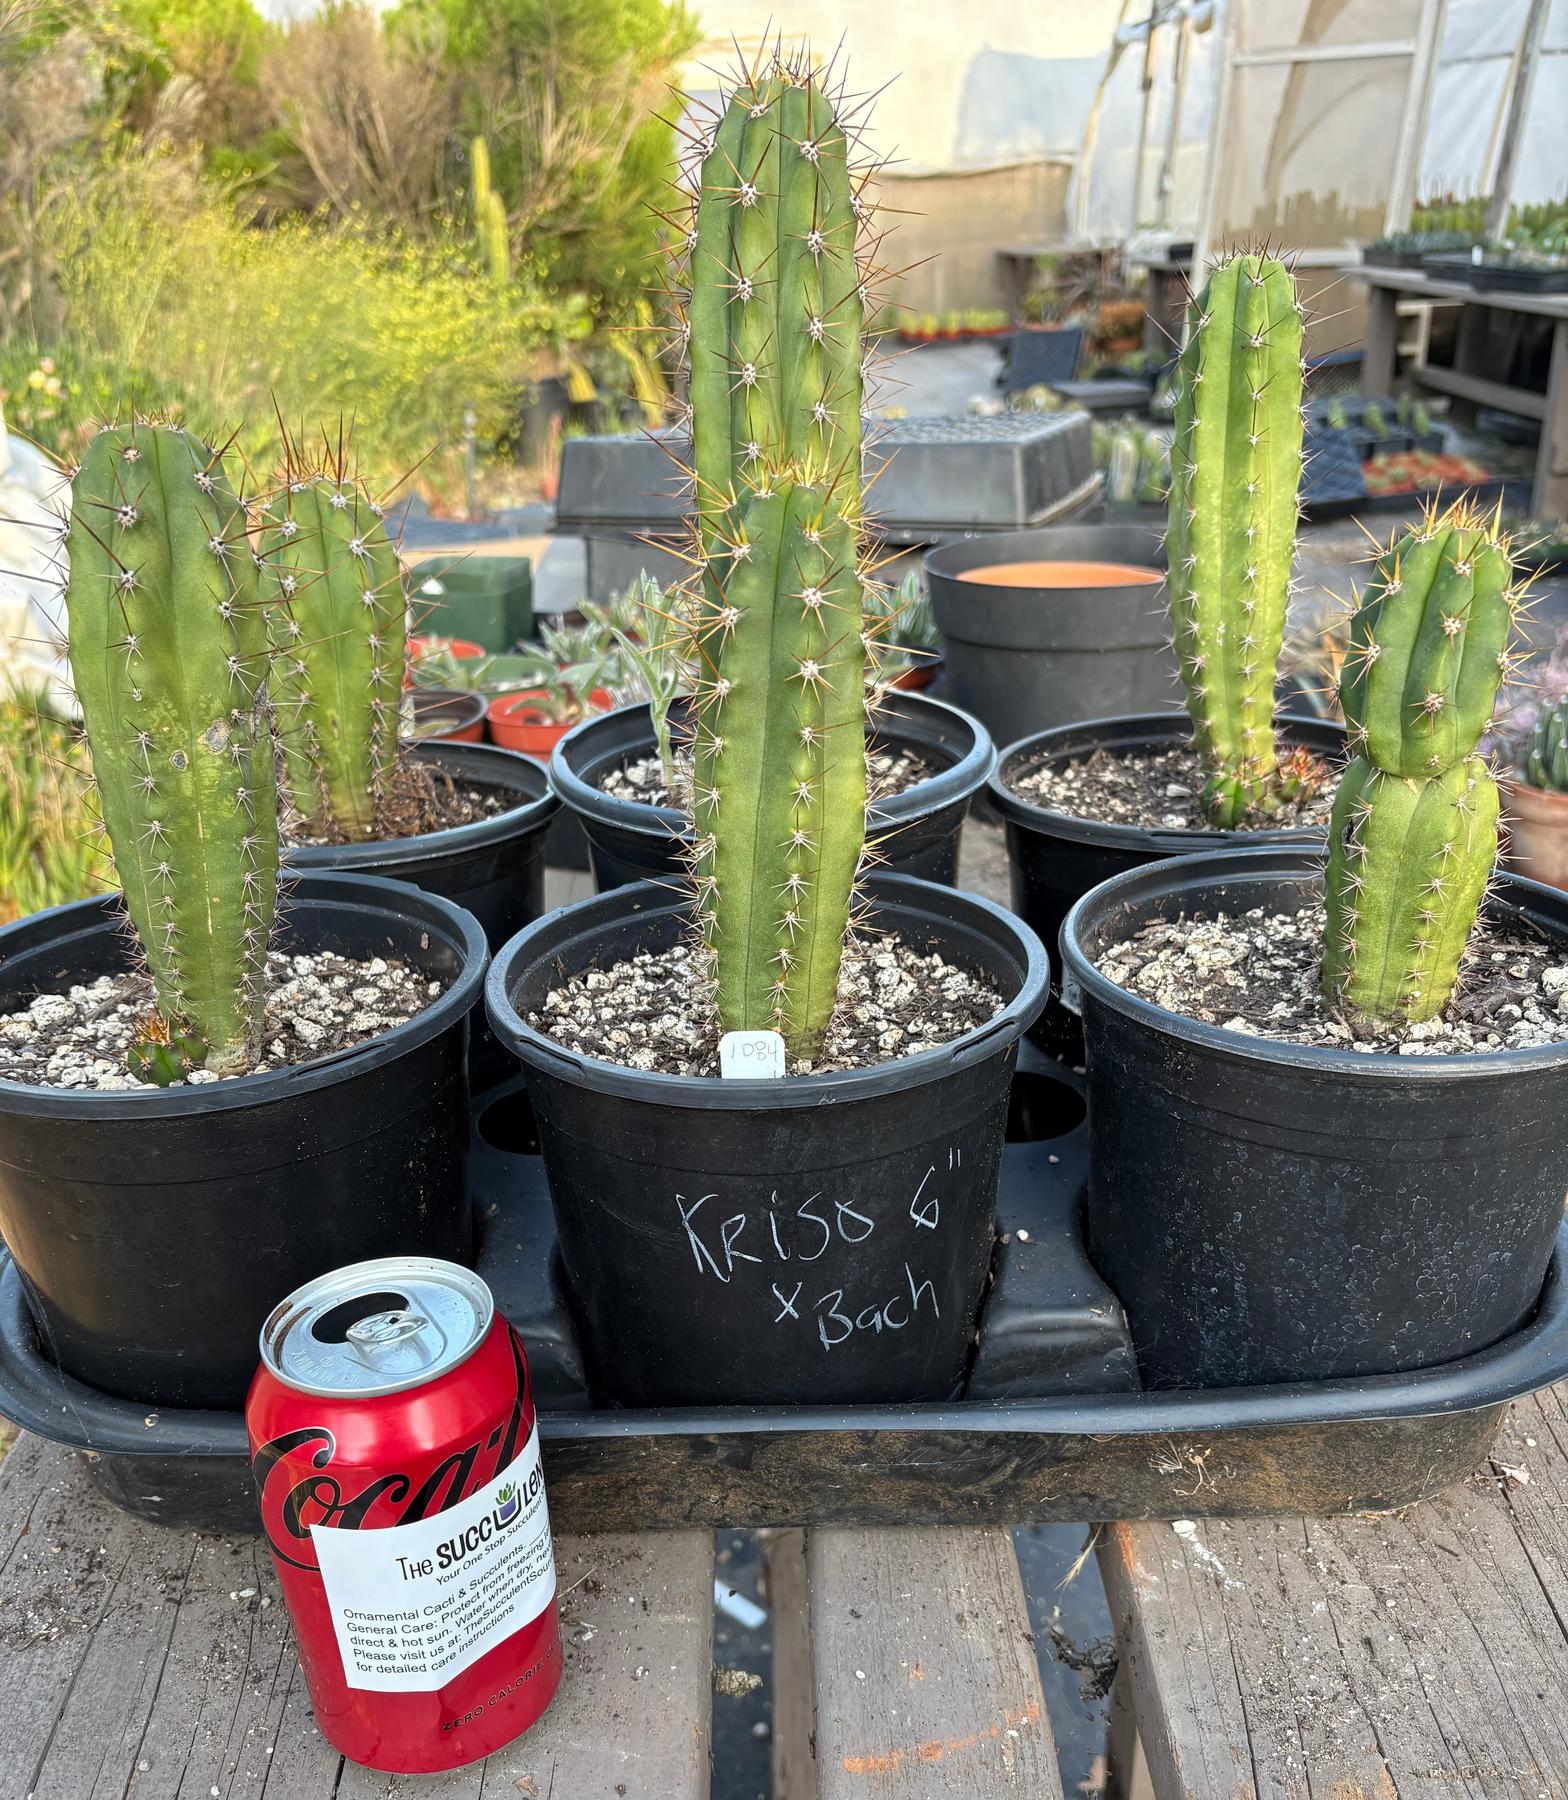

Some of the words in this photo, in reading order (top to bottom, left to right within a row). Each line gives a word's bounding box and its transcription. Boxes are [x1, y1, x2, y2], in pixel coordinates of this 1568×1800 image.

[729, 1039, 778, 1063] 1084
[343, 1608, 419, 1622] Ornamental
[423, 1594, 455, 1616] Cacti
[458, 1588, 467, 1599] &
[469, 1545, 526, 1591] Succulents.
[347, 1622, 397, 1635] General
[401, 1620, 438, 1634] Care:
[441, 1591, 481, 1623] Protect
[482, 1572, 505, 1595] from
[507, 1538, 544, 1575] freezing
[436, 1568, 461, 1586] Your
[463, 1554, 483, 1570] One
[485, 1536, 506, 1556] Stop
[350, 1636, 385, 1648] direct
[388, 1638, 398, 1648] &
[402, 1638, 423, 1648] hot
[427, 1628, 453, 1645] sun.
[455, 1601, 486, 1628] Water
[488, 1578, 514, 1602] when
[353, 1648, 396, 1661] Please
[399, 1650, 427, 1661] visit
[430, 1645, 445, 1658] us
[447, 1633, 462, 1648] at:
[356, 1661, 373, 1673] for
[376, 1663, 427, 1674] detailed
[431, 1651, 456, 1671] care
[458, 1603, 515, 1652] instructions
[442, 1705, 485, 1732] ZERO
[488, 1658, 544, 1707] CALORIE
